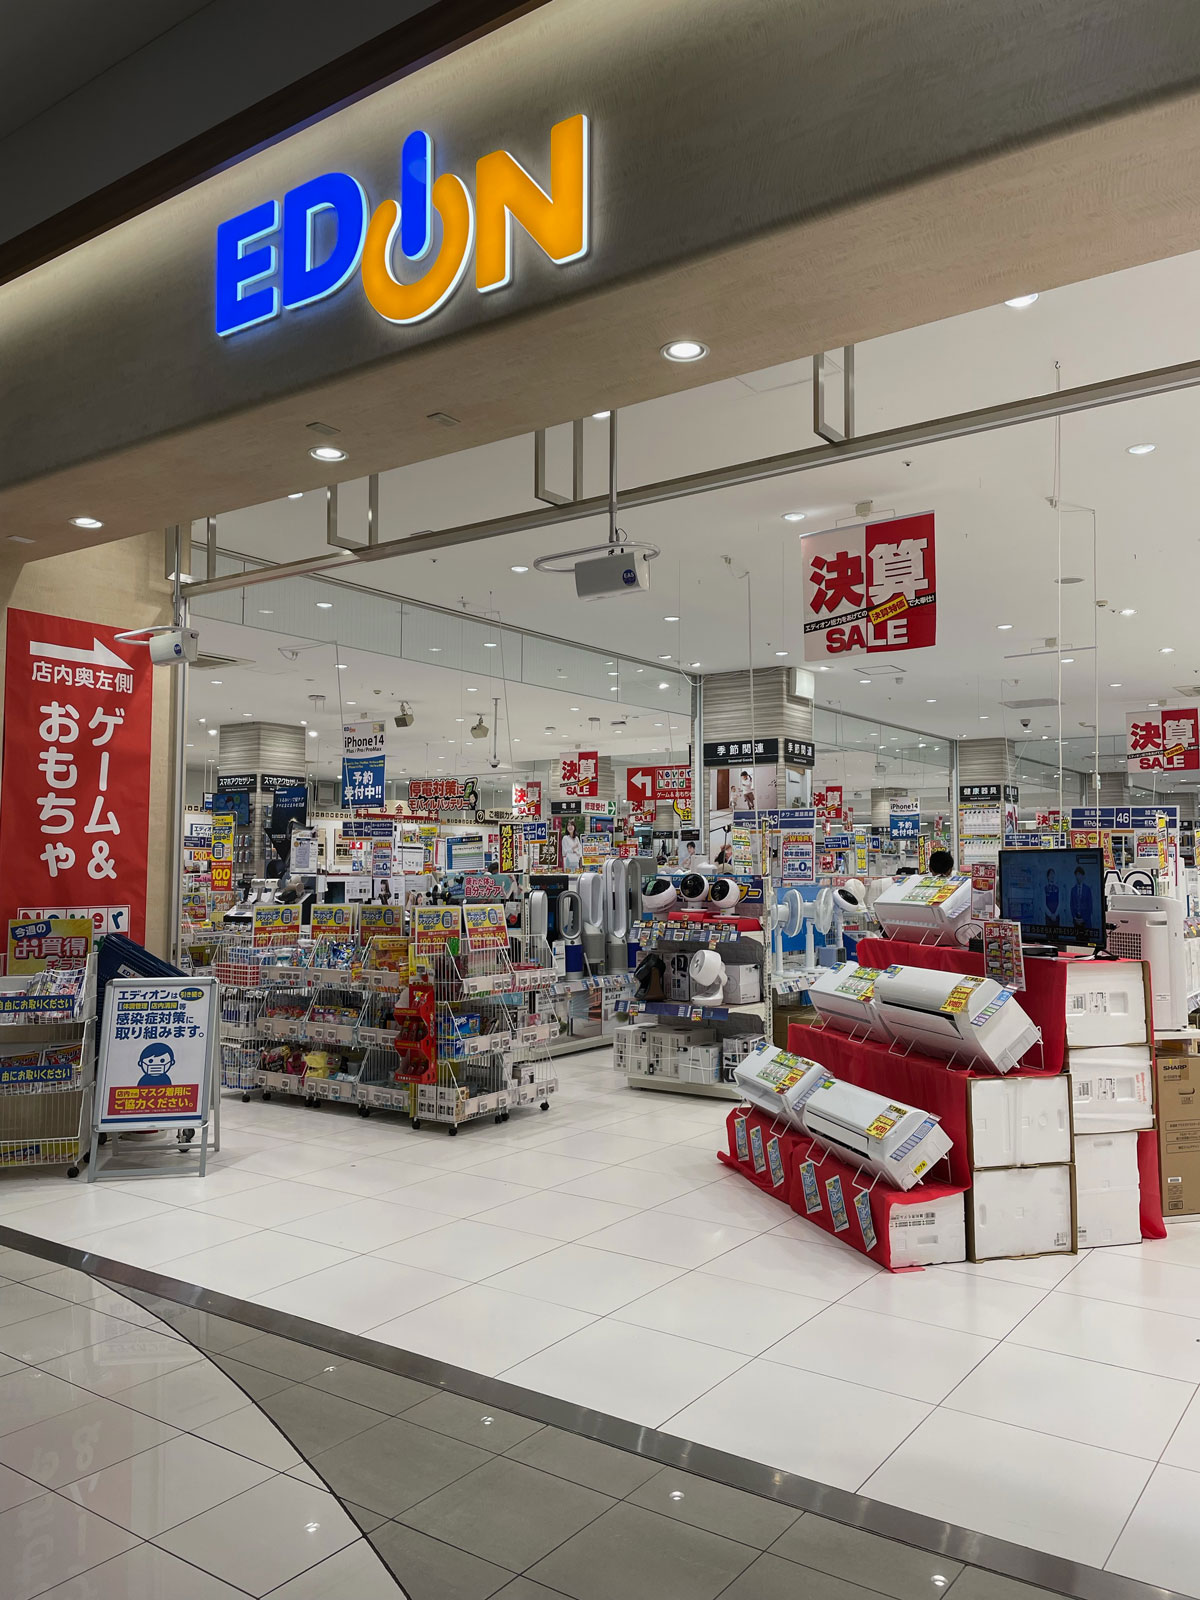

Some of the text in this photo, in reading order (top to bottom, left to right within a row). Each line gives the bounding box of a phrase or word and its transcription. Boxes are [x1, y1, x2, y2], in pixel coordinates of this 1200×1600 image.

[216, 113, 593, 337] EDION
[809, 537, 929, 614] 決算
[826, 618, 909, 654] SALE
[32, 661, 133, 694] 店内奥左側
[344, 735, 385, 748] iPhone14
[1130, 718, 1196, 751] 決算
[717, 743, 765, 756] 季節関連
[787, 743, 813, 757] 季節関連
[561, 759, 598, 781] 決算
[1139, 755, 1185, 770] SALE
[352, 770, 373, 786] 予約
[658, 779, 686, 789] Land
[37, 700, 80, 879] おもちゃ
[408, 779, 465, 798] 停電対策に
[566, 785, 591, 796] SALE
[1117, 812, 1130, 824] 46
[537, 826, 546, 836] 42
[212, 868, 231, 880] 100
[15, 923, 47, 939] 今週の
[15, 937, 88, 960] お買得
[116, 1012, 194, 1026] 感染症対策に
[115, 1025, 204, 1041] 取り組みます。
[1163, 1064, 1187, 1072] SHARP
[114, 1098, 194, 1111] ご協力ください。
